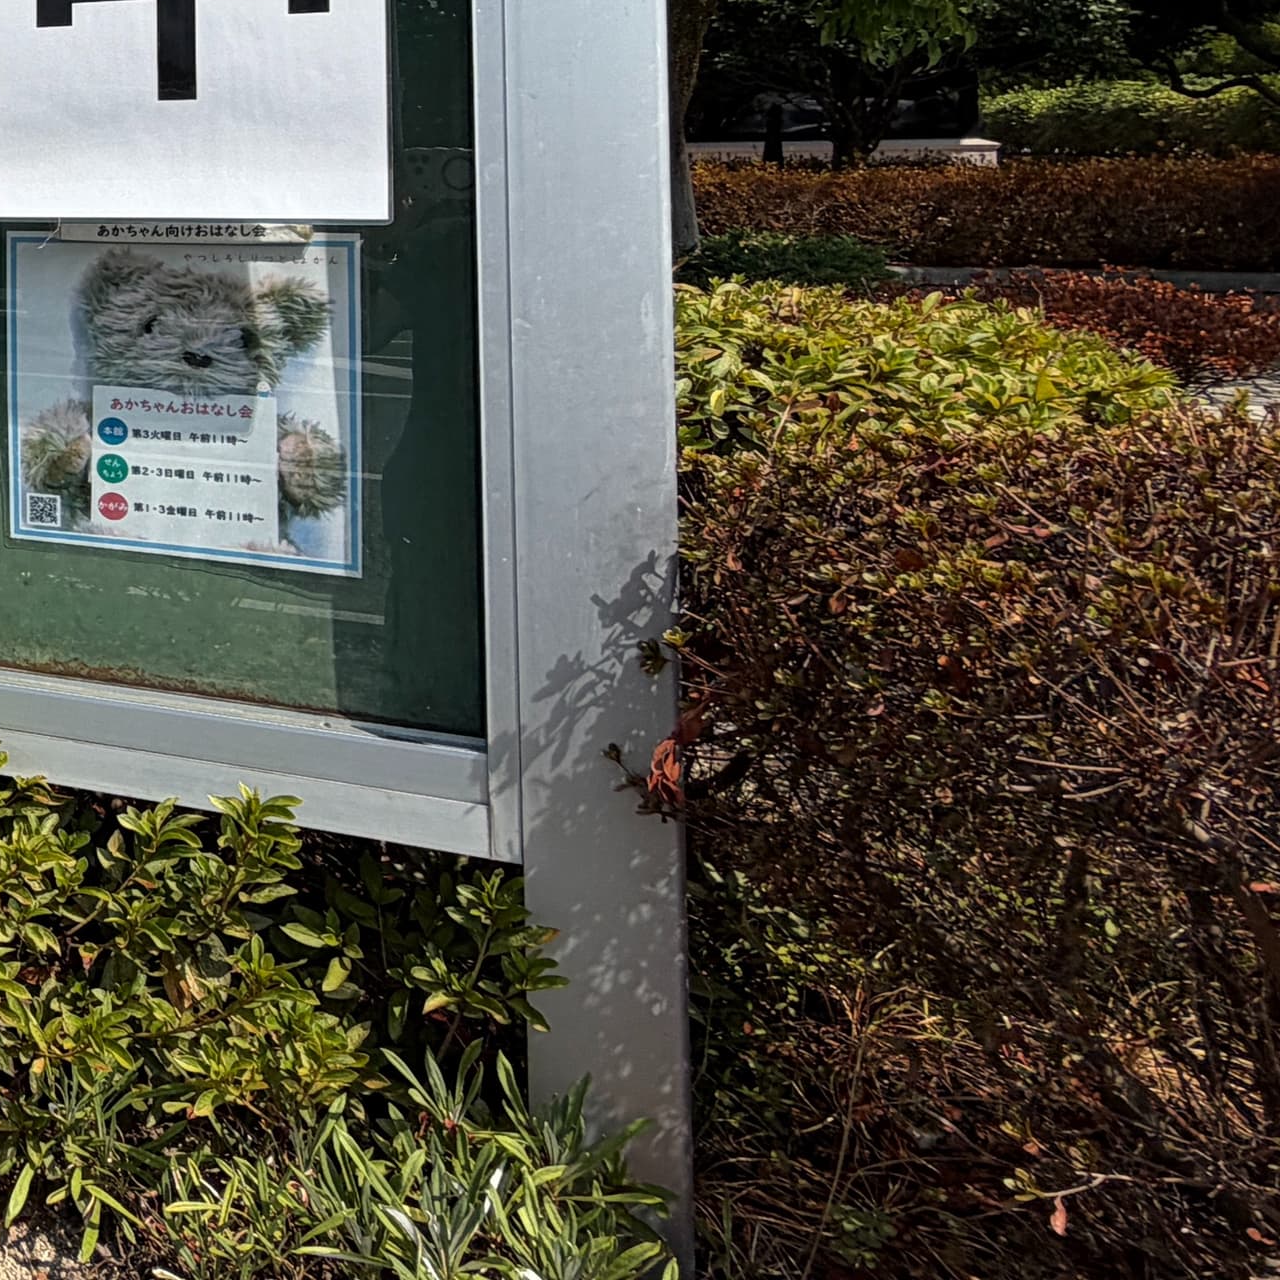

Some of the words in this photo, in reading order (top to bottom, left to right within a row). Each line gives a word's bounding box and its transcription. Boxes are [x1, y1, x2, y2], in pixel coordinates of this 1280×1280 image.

[97, 224, 267, 237] あかちゃん向けおはなし会
[110, 398, 255, 419] あかちゃんおはなし会
[132, 428, 182, 442] 第3火曜日
